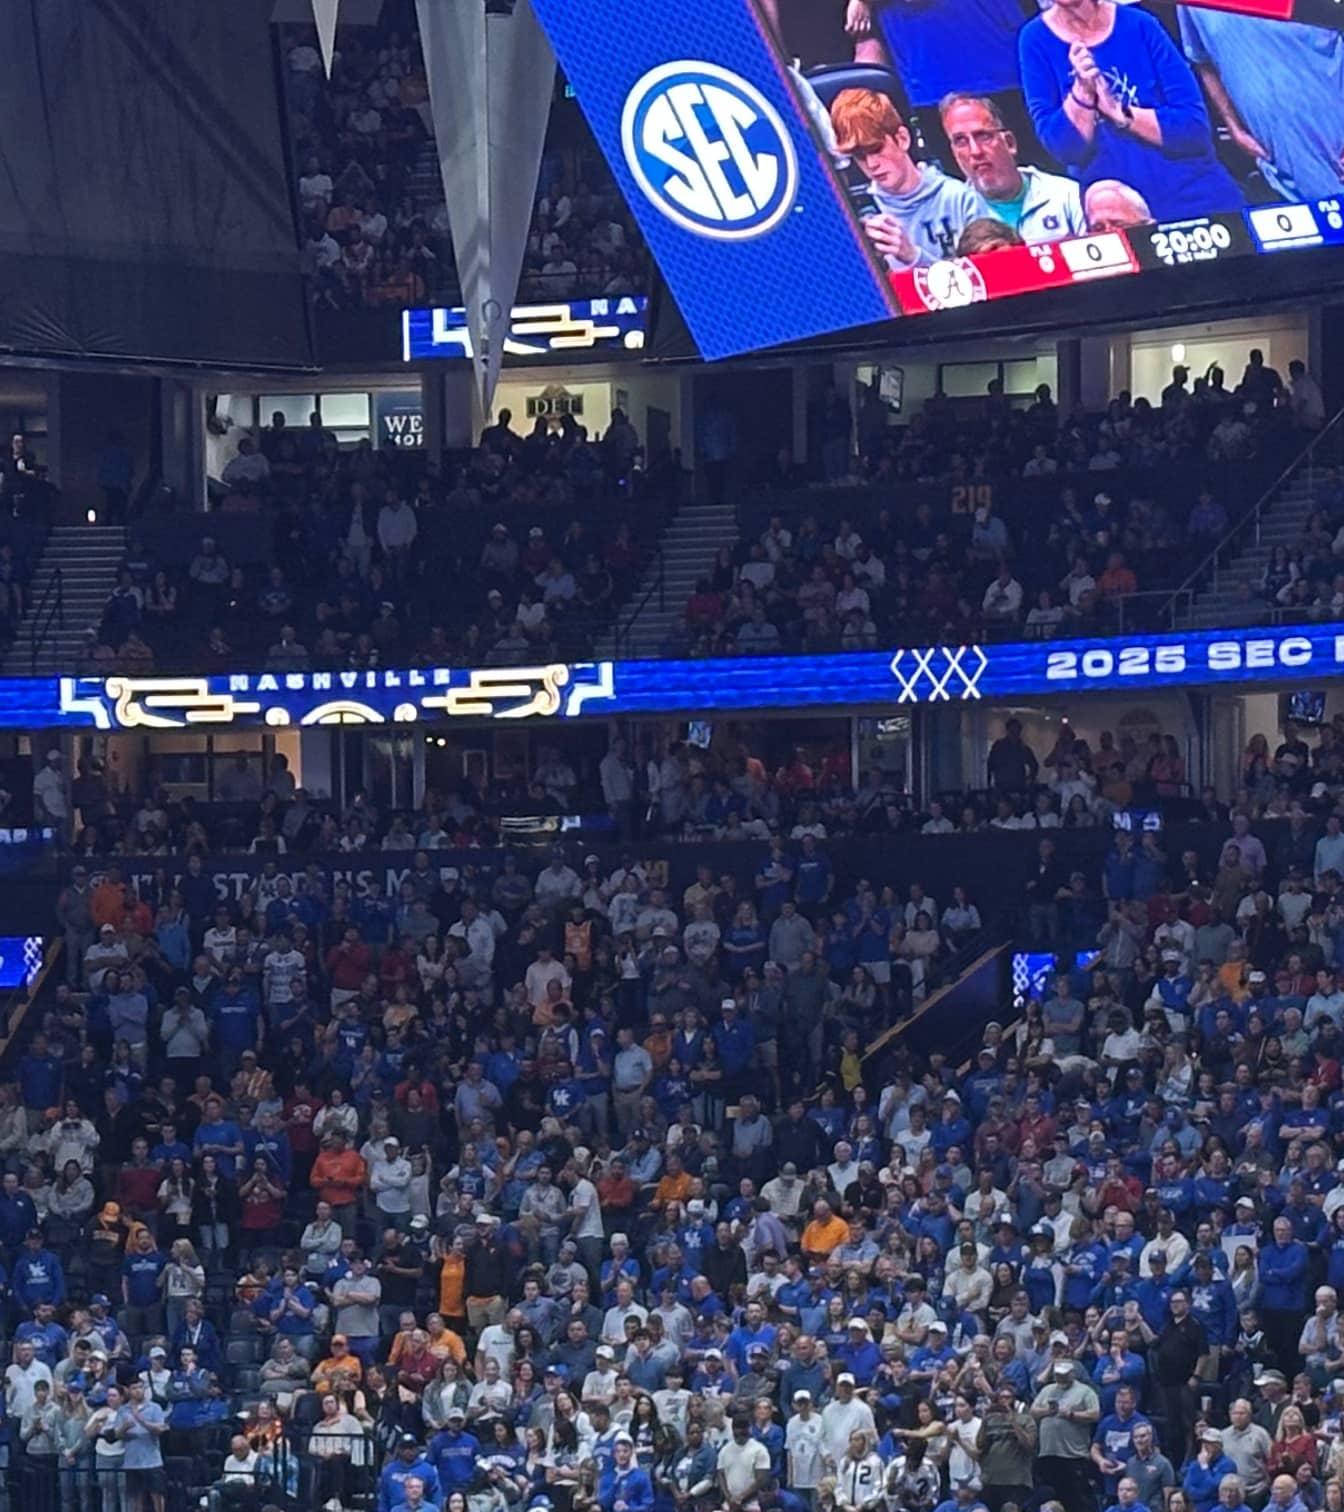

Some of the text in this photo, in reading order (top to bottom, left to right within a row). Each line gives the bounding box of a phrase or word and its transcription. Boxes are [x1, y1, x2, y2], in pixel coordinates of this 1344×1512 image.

[642, 82, 778, 222] SEC
[1276, 213, 1293, 233] 0
[1085, 243, 1103, 262] 0
[1150, 224, 1231, 258] 20:00
[1046, 645, 1187, 680] 2025
[1207, 637, 1313, 671] SEC
[229, 669, 452, 692] NASHVILLE
